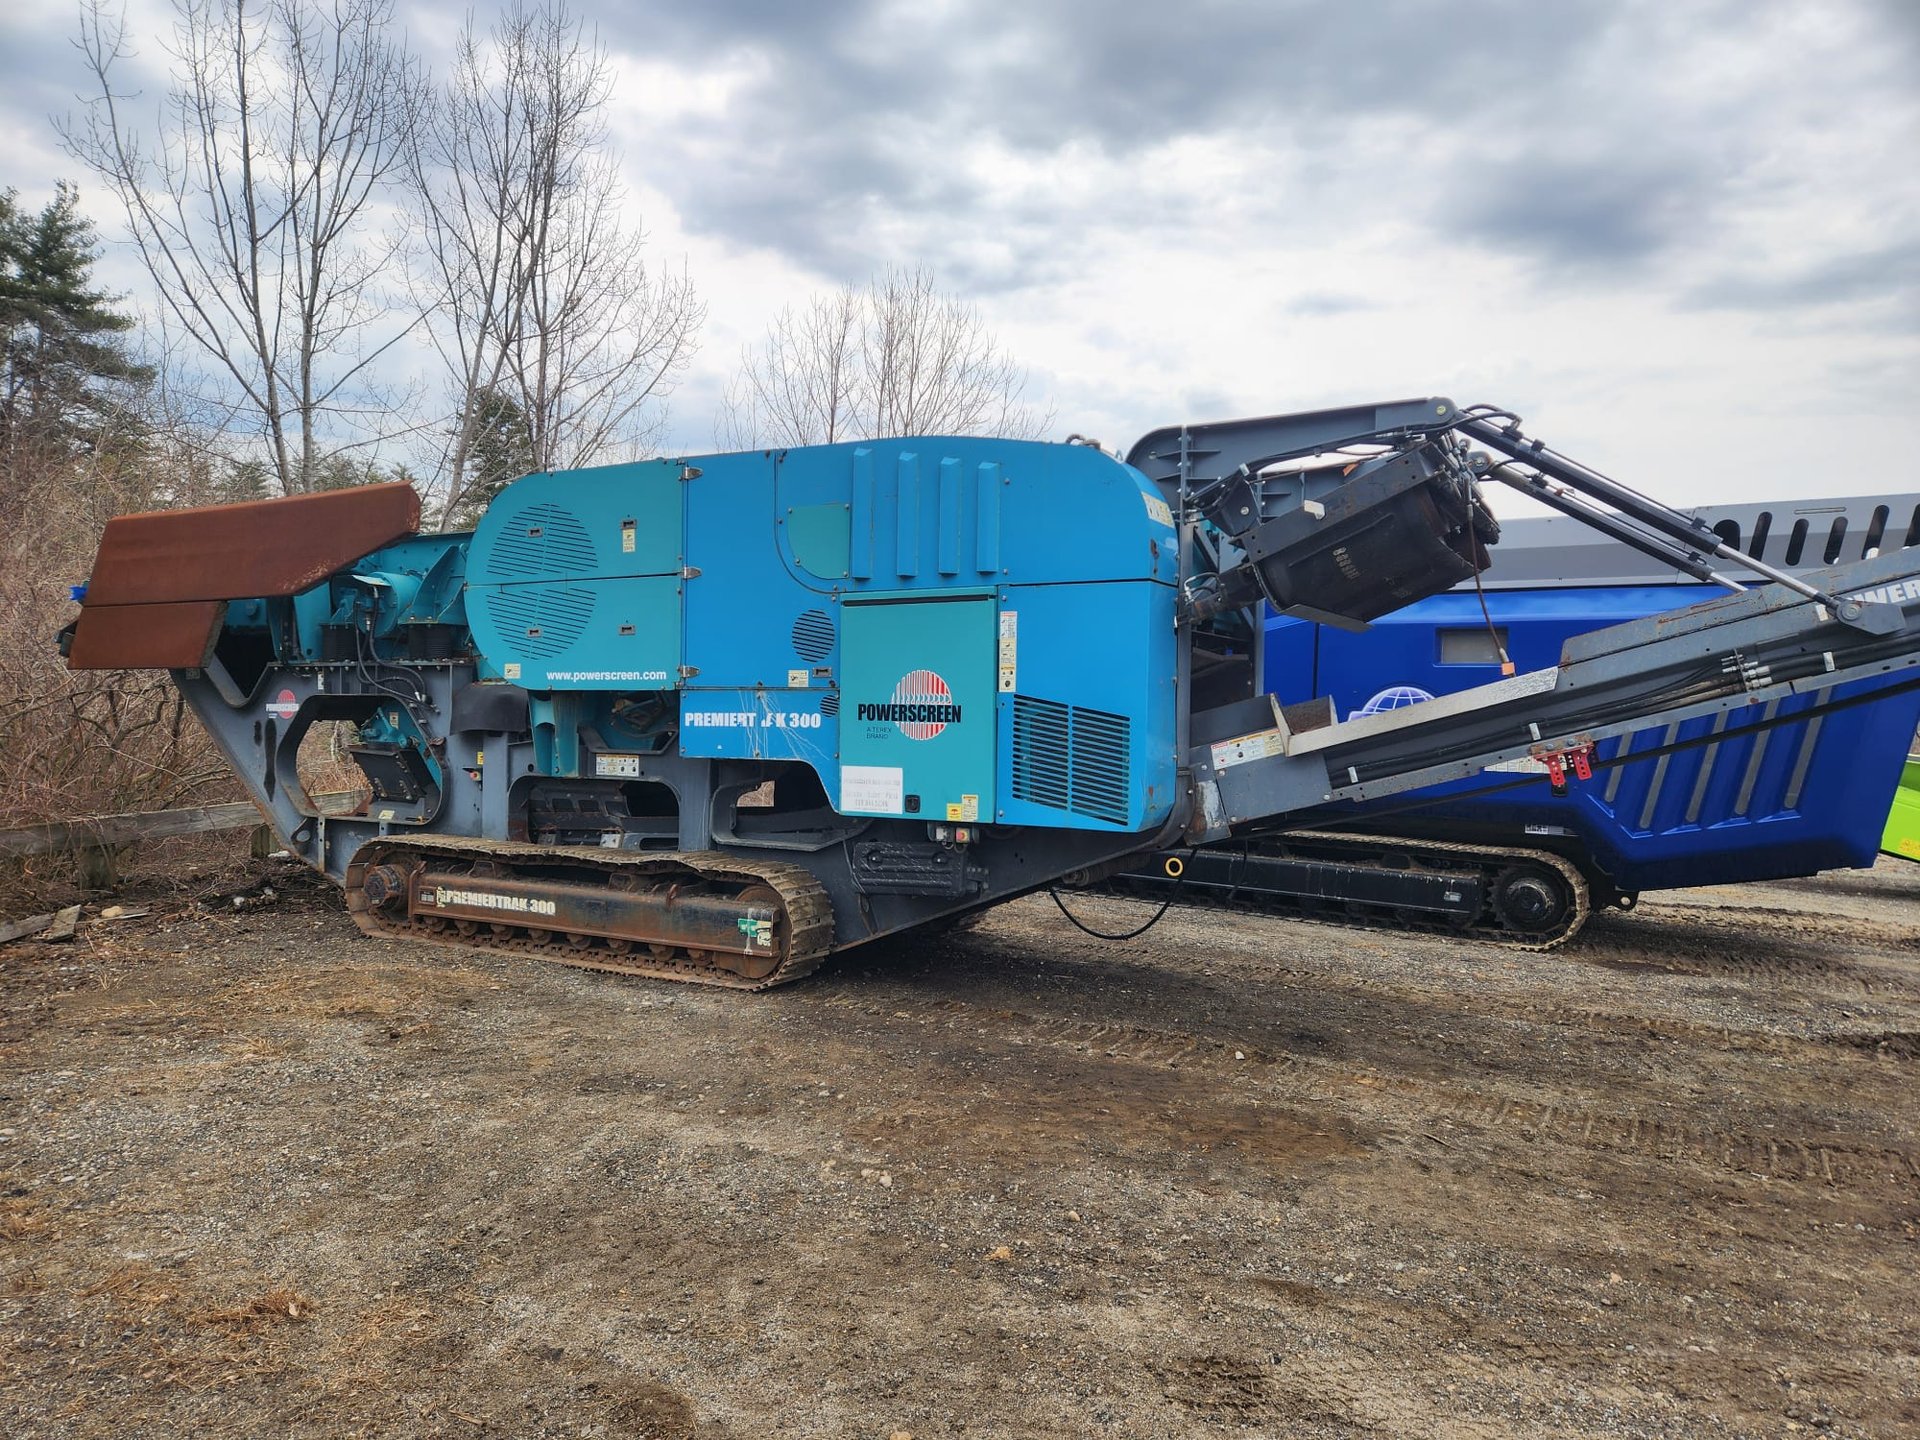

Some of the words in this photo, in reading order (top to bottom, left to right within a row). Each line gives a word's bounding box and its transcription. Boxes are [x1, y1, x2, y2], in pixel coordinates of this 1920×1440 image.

[546, 671, 667, 683] www.powerscreen.com
[789, 713, 822, 728] 300
[857, 703, 962, 723] POWERSCREEN
[529, 899, 556, 916] 300
